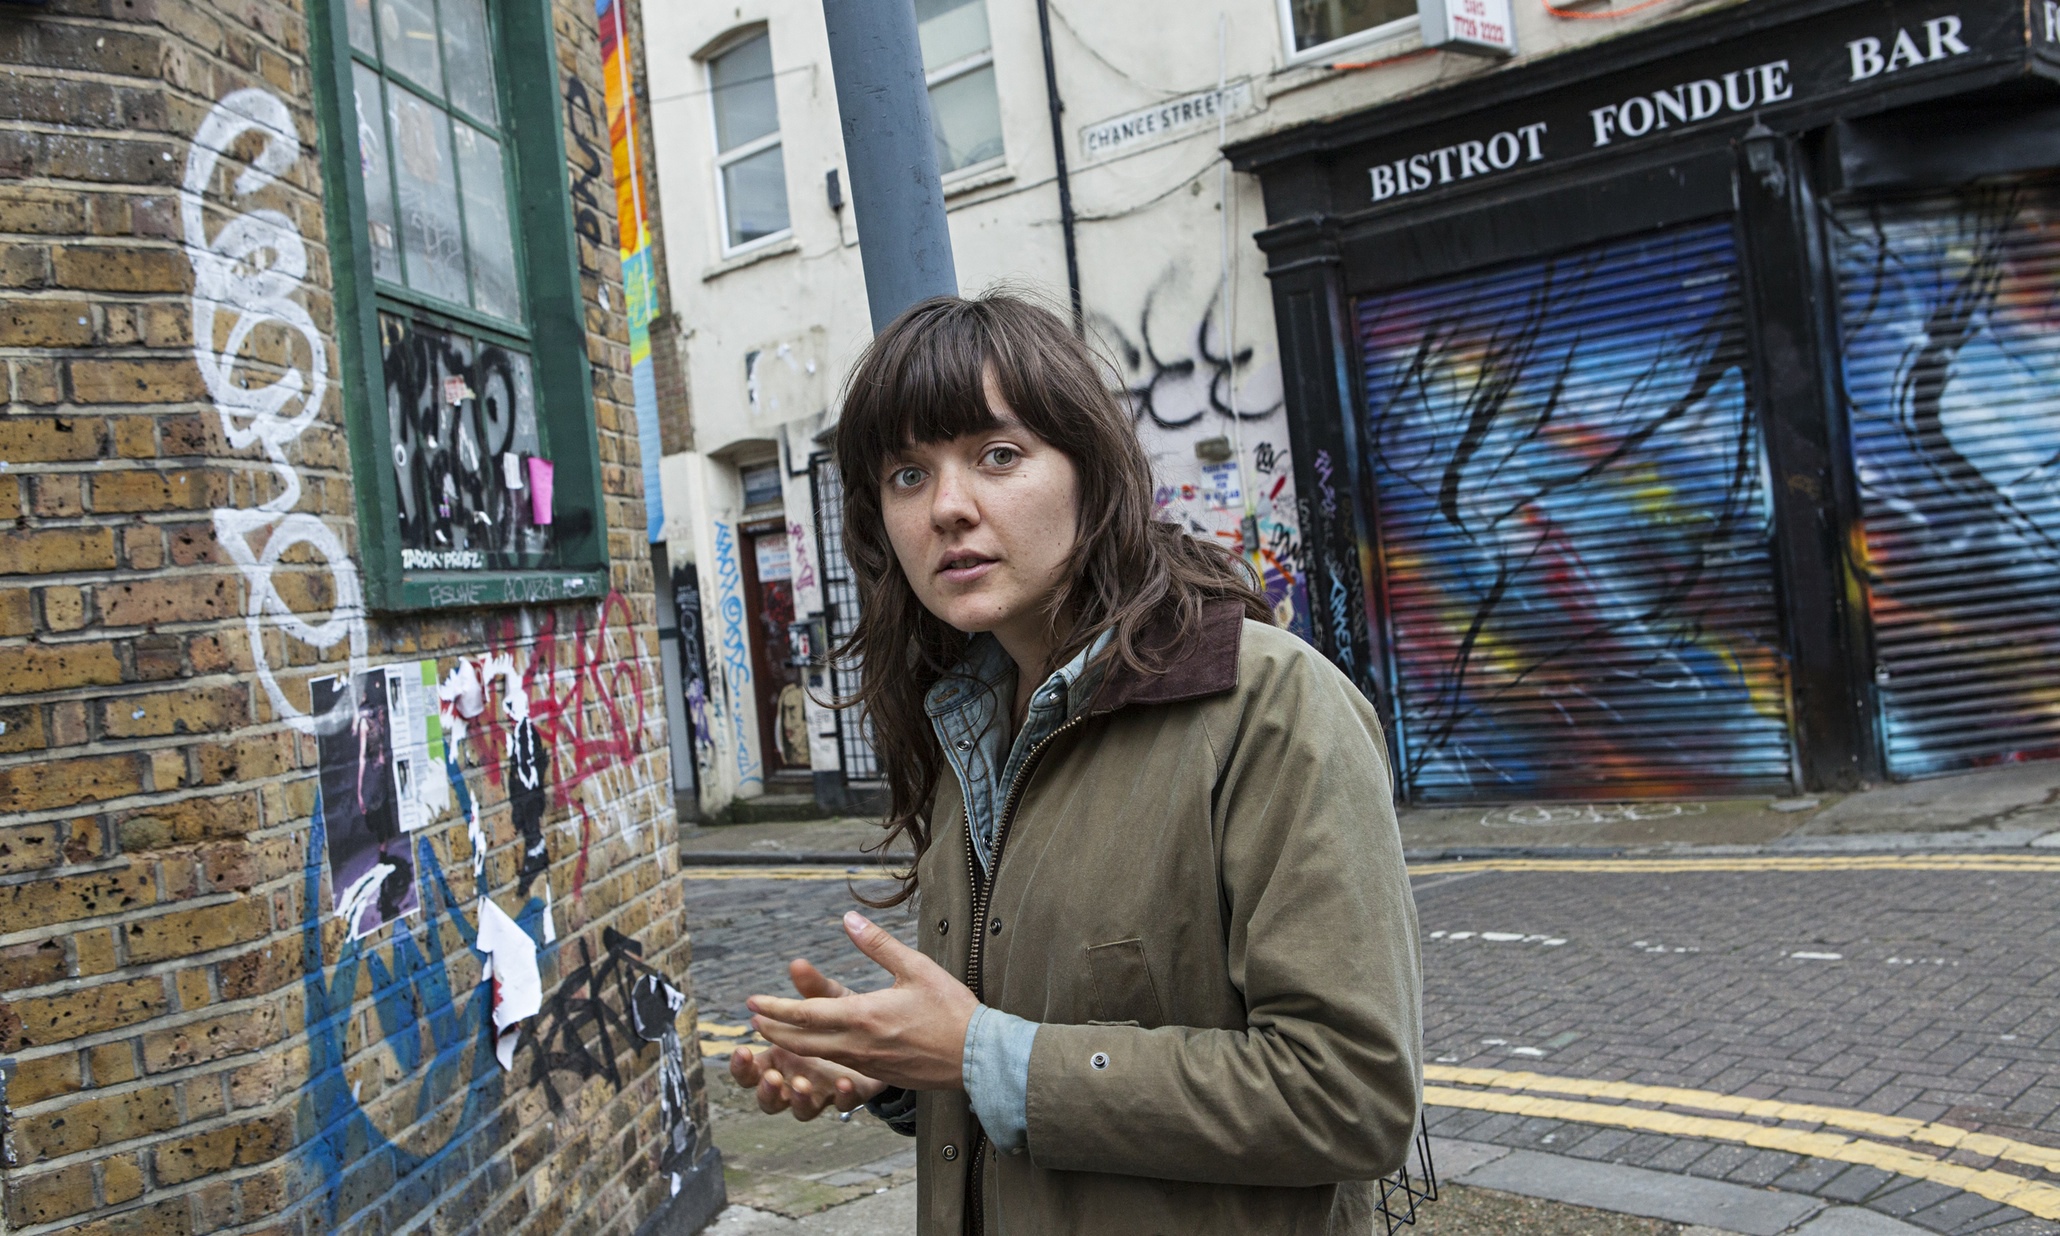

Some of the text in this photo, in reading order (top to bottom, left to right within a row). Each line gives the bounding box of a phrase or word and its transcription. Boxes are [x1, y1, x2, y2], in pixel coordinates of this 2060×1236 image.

[1480, 22, 1504, 43] 2222
[1087, 114, 1154, 151] CHANCE
[1160, 91, 1223, 129] STREET
[1368, 15, 1970, 202] BISTROT FONDUE BAR
